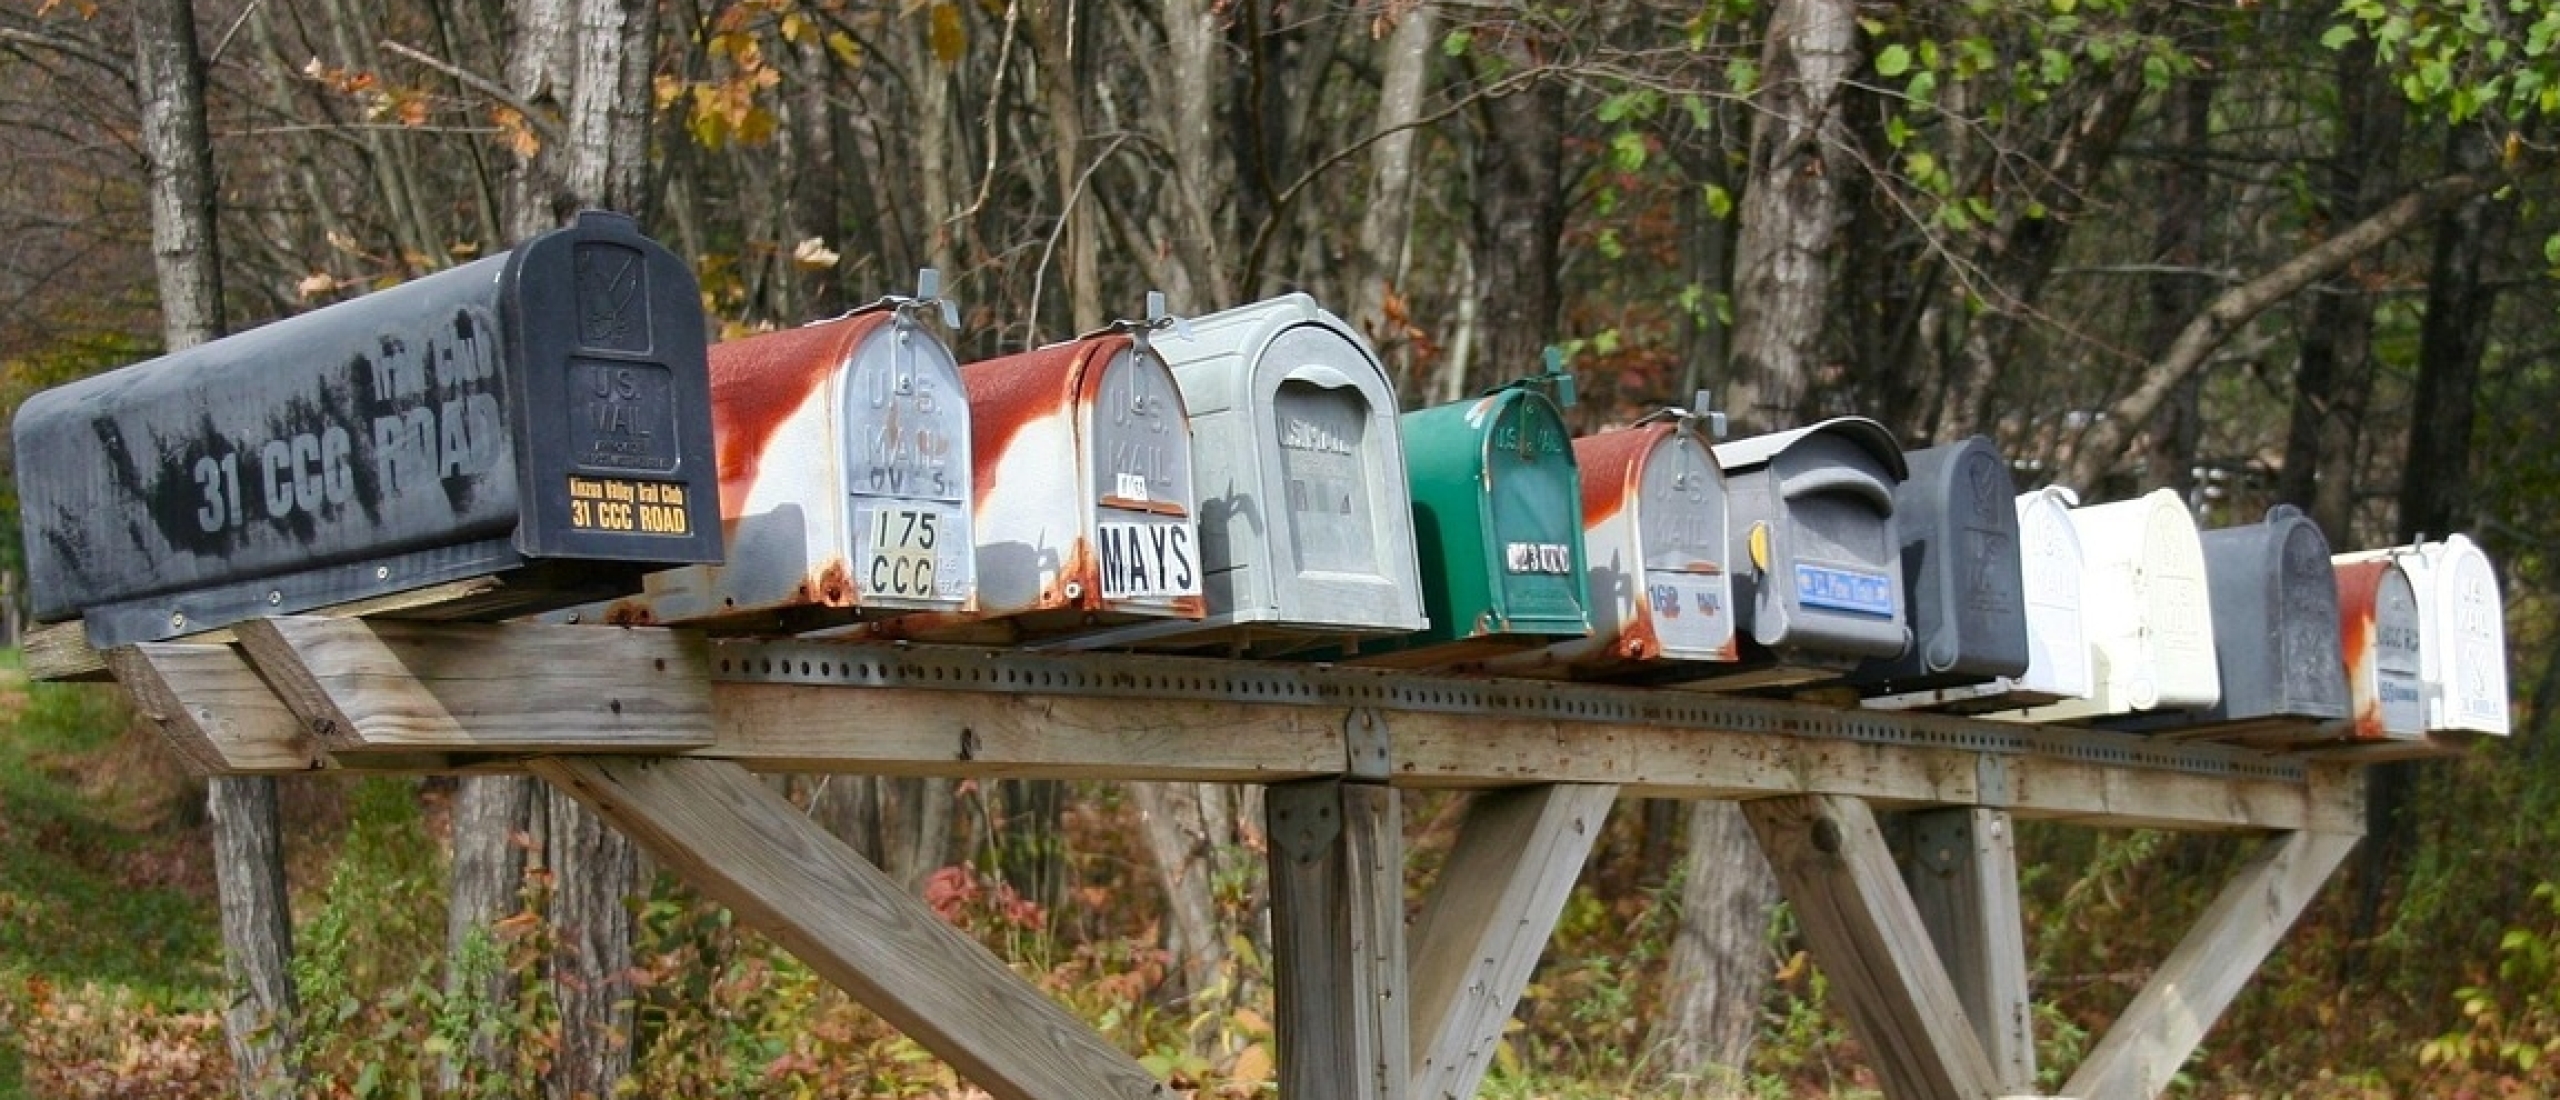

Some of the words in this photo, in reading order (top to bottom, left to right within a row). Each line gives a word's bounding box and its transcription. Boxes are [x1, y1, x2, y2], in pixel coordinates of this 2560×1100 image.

[195, 453, 242, 532] 31
[262, 427, 351, 517] CCC
[375, 393, 500, 499] ROAD
[864, 423, 946, 470] MAIL
[1108, 440, 1172, 488] MAIL
[572, 500, 591, 527] 31
[598, 501, 632, 530] CCC
[640, 504, 685, 532] ROAD
[879, 510, 936, 550] 175
[872, 555, 931, 597] CCC
[1100, 524, 1191, 594] MAYS
